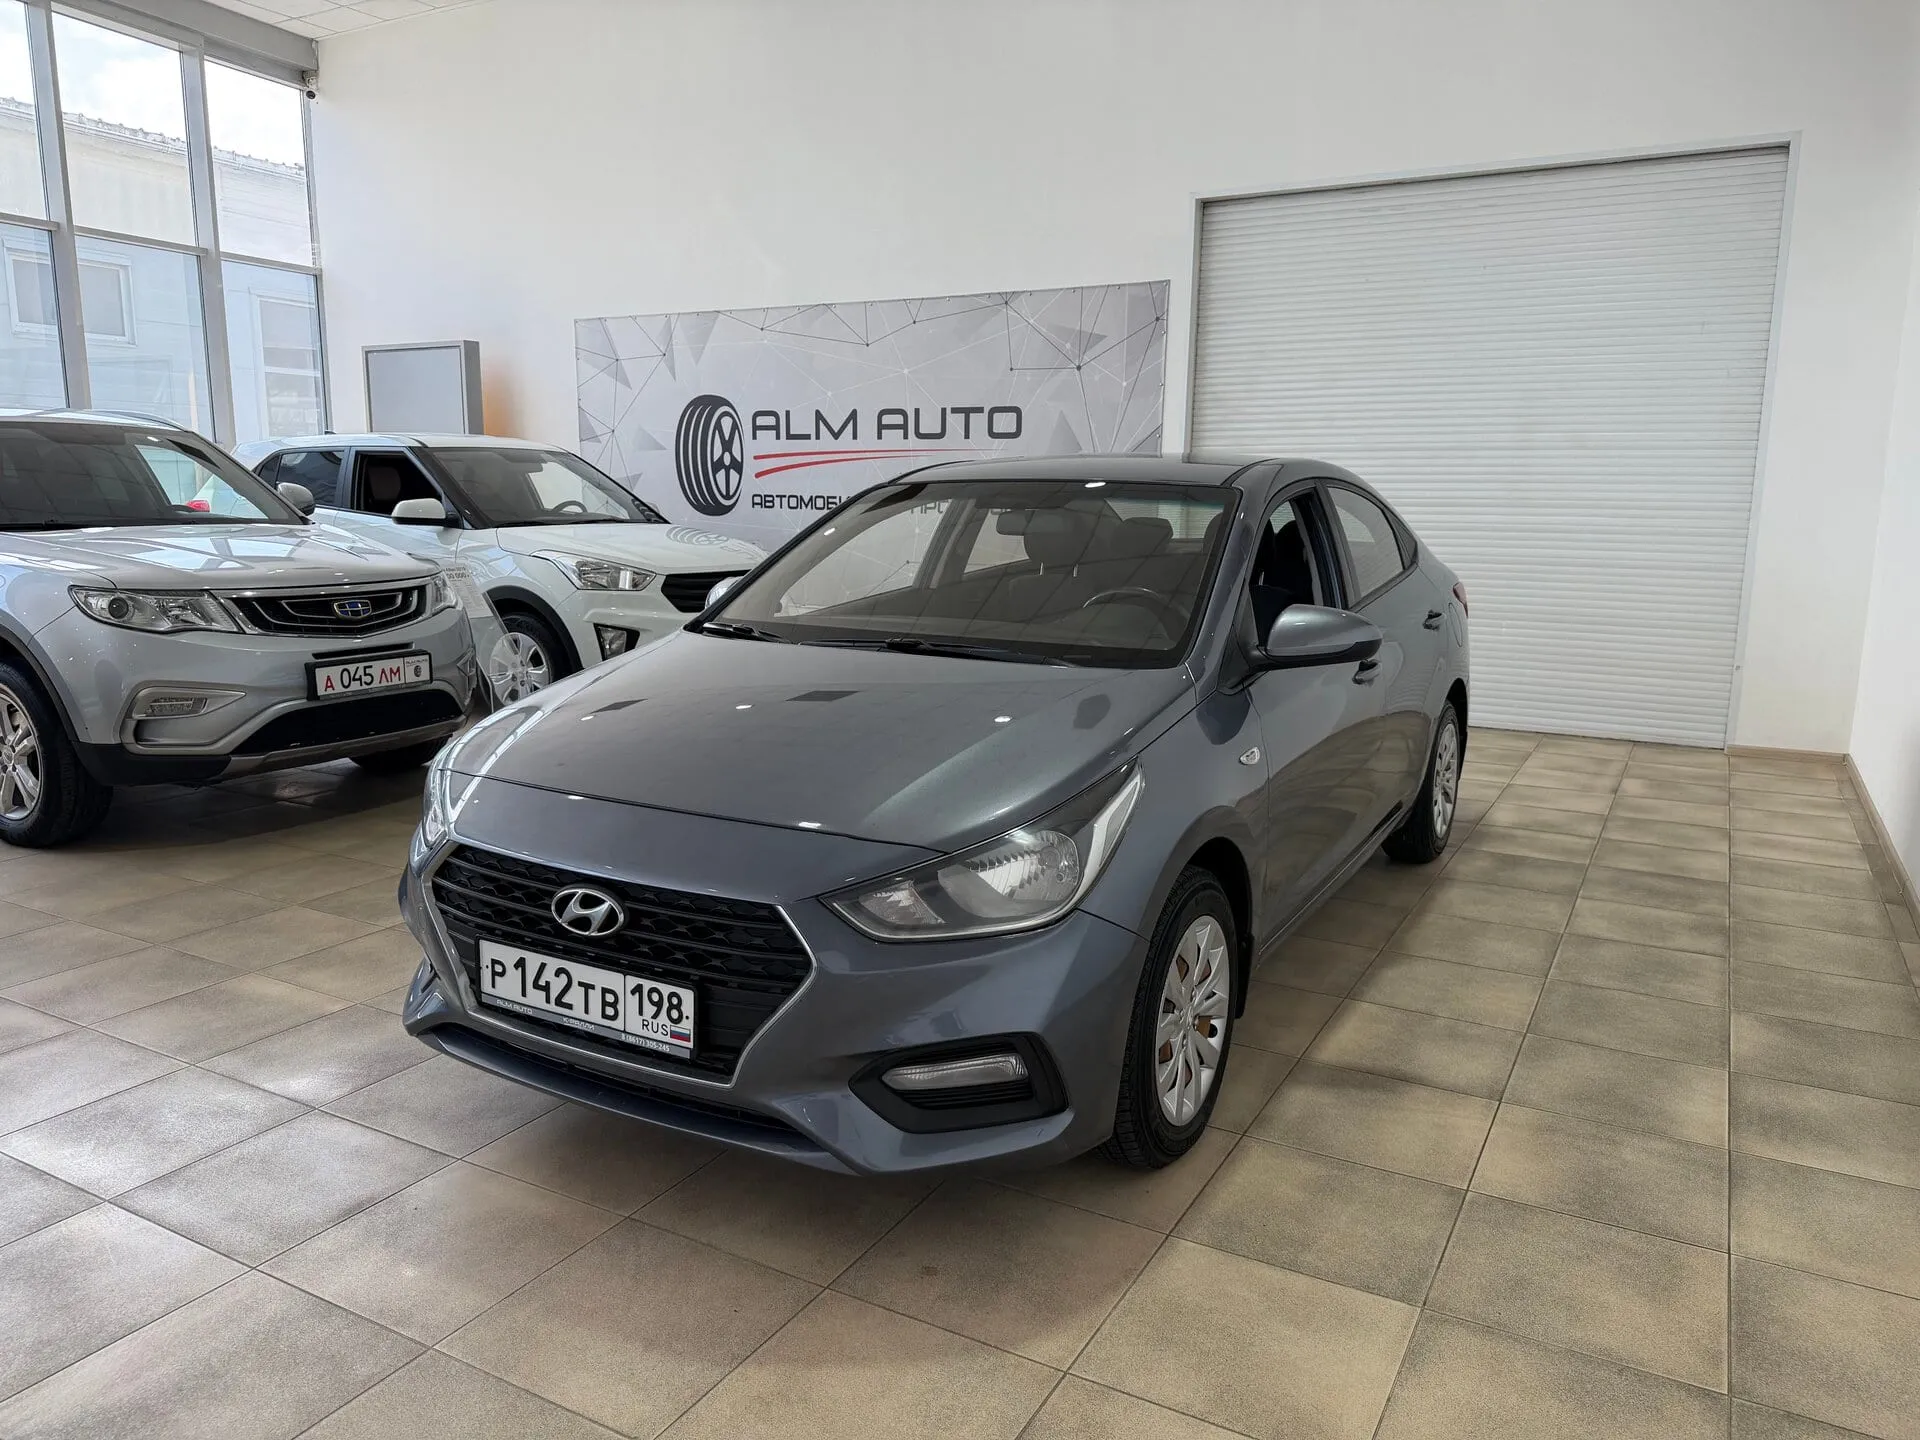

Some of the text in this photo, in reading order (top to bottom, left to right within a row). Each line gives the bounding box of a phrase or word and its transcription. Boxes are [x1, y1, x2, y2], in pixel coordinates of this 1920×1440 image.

[752, 405, 1023, 441] ALM AUTO
[340, 665, 375, 689] 045
[630, 983, 684, 1025] 198
[641, 1019, 669, 1037] RUS
